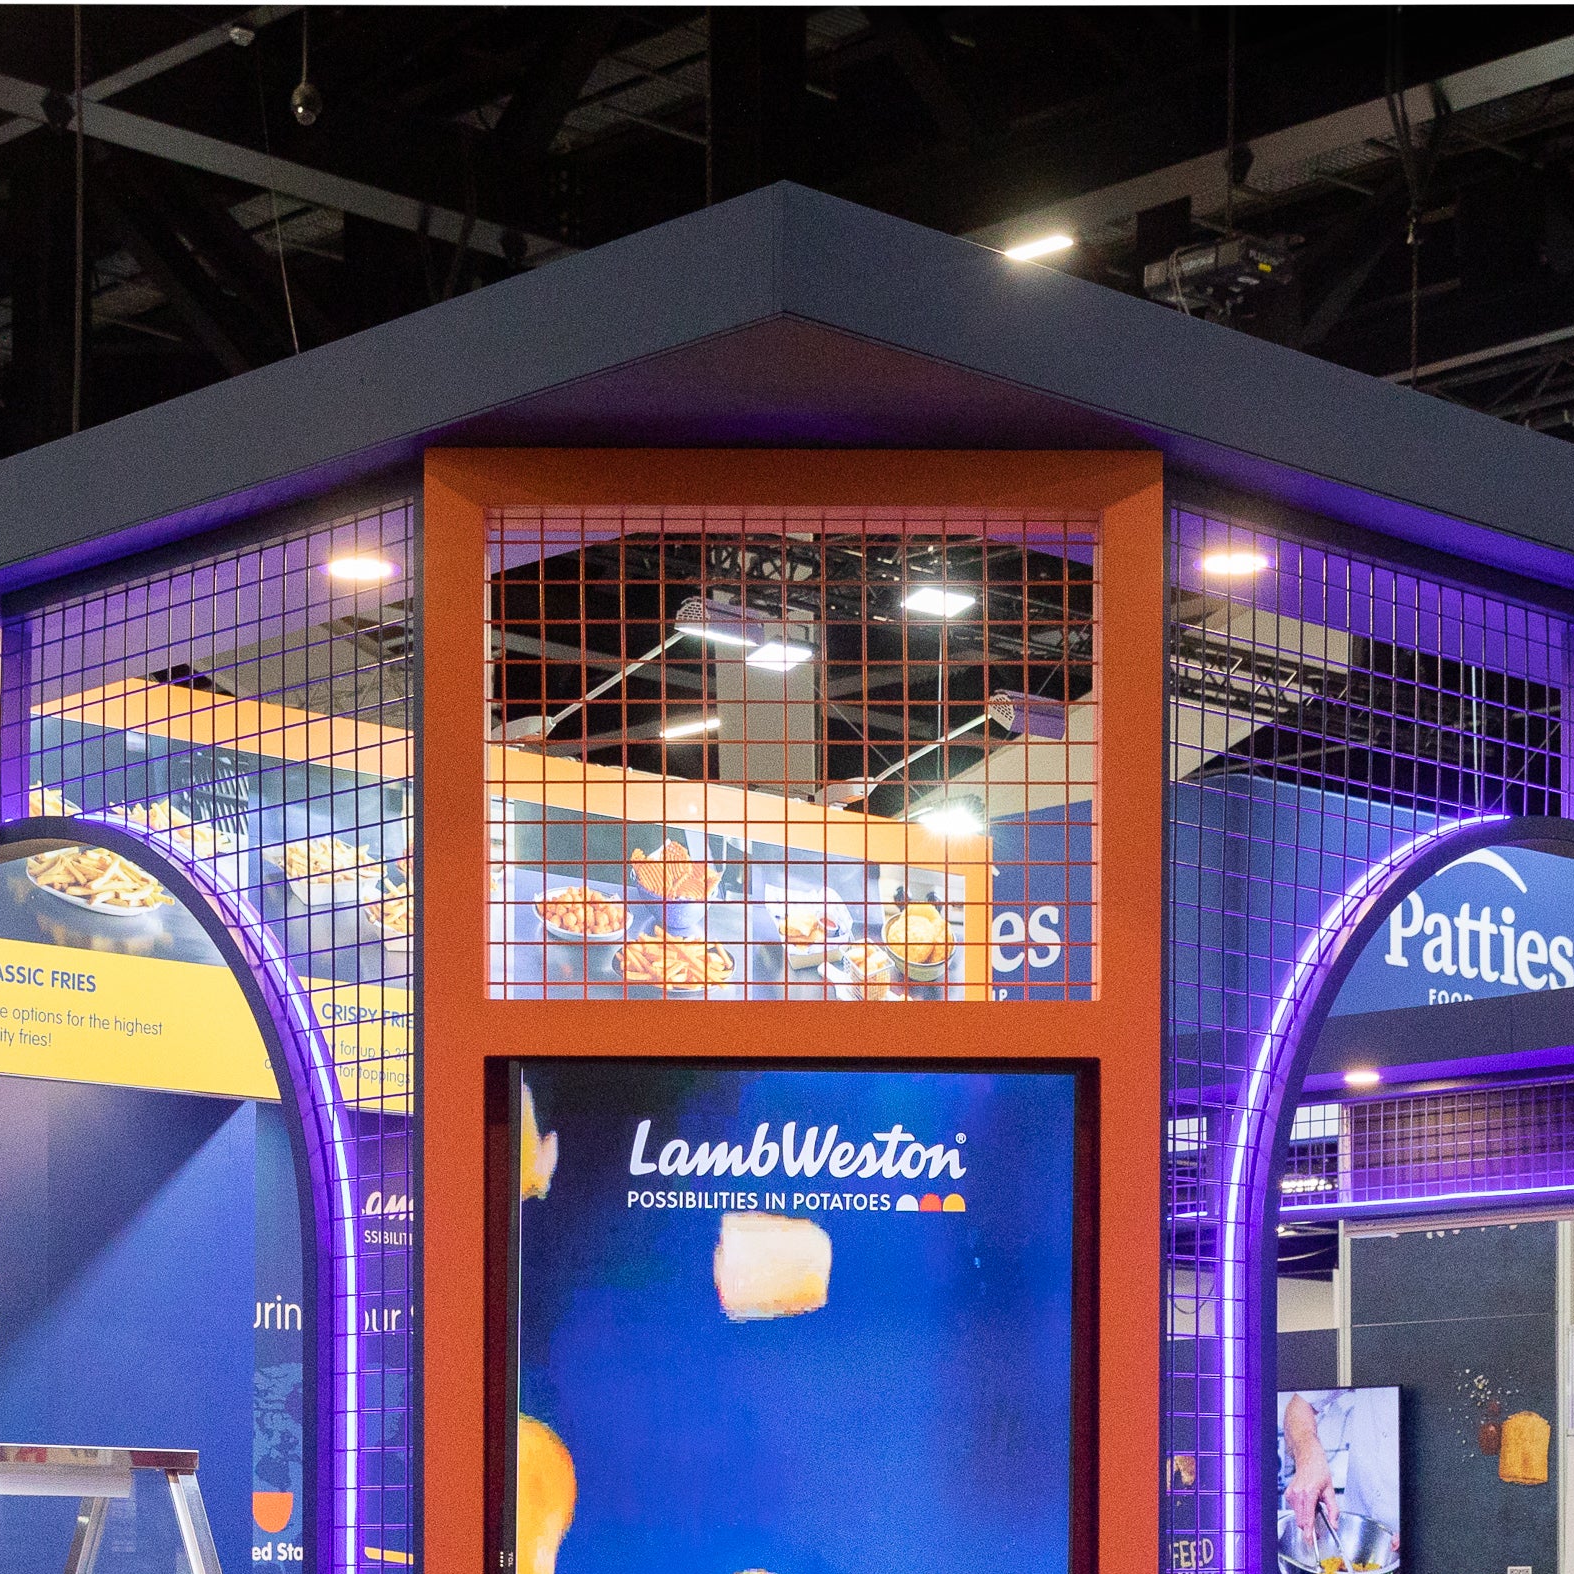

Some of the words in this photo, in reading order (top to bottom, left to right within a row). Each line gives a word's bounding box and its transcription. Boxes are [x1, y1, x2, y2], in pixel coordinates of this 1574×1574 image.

[51, 970, 96, 992] FRIES
[12, 1007, 63, 1025] options
[67, 1010, 85, 1027] for
[89, 1013, 110, 1030] the
[115, 1017, 163, 1036] highest
[322, 1003, 378, 1025] CRISPY
[19, 1028, 52, 1047] fries!
[628, 1118, 966, 1180] LambWeston
[627, 1190, 758, 1211] POSSIBILITIES
[765, 1190, 787, 1211] IN
[792, 1191, 892, 1212] POTATOES
